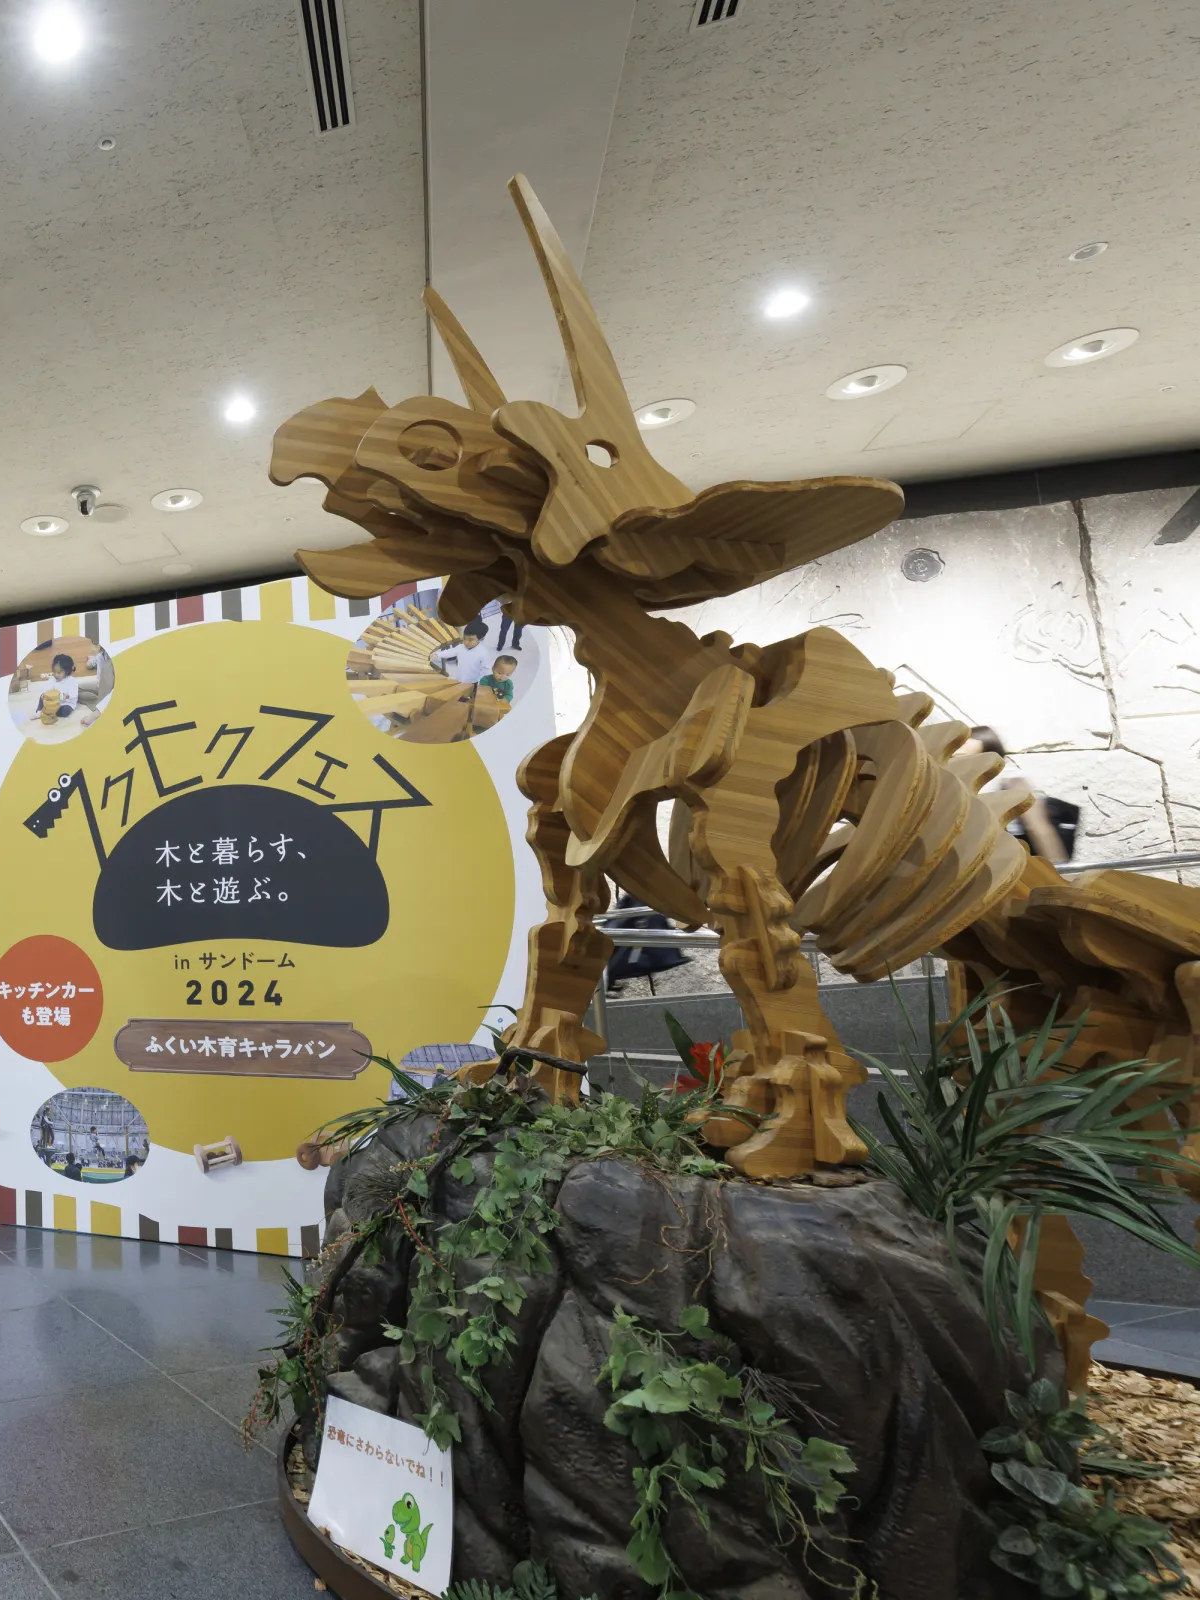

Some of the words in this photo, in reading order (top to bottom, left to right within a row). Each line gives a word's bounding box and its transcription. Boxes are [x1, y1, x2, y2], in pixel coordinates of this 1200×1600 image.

[154, 833, 307, 868] 木と暮らす、
[156, 876, 290, 907] 木と遊ぶ。
[174, 953, 190, 970] in
[199, 951, 296, 970] サンドーム
[186, 979, 284, 1007] 2024
[21, 1006, 71, 1028] も登場
[145, 1034, 337, 1061] ふくい木育キャラバン
[326, 1424, 444, 1487] 恐竜にさわらないでね！！
